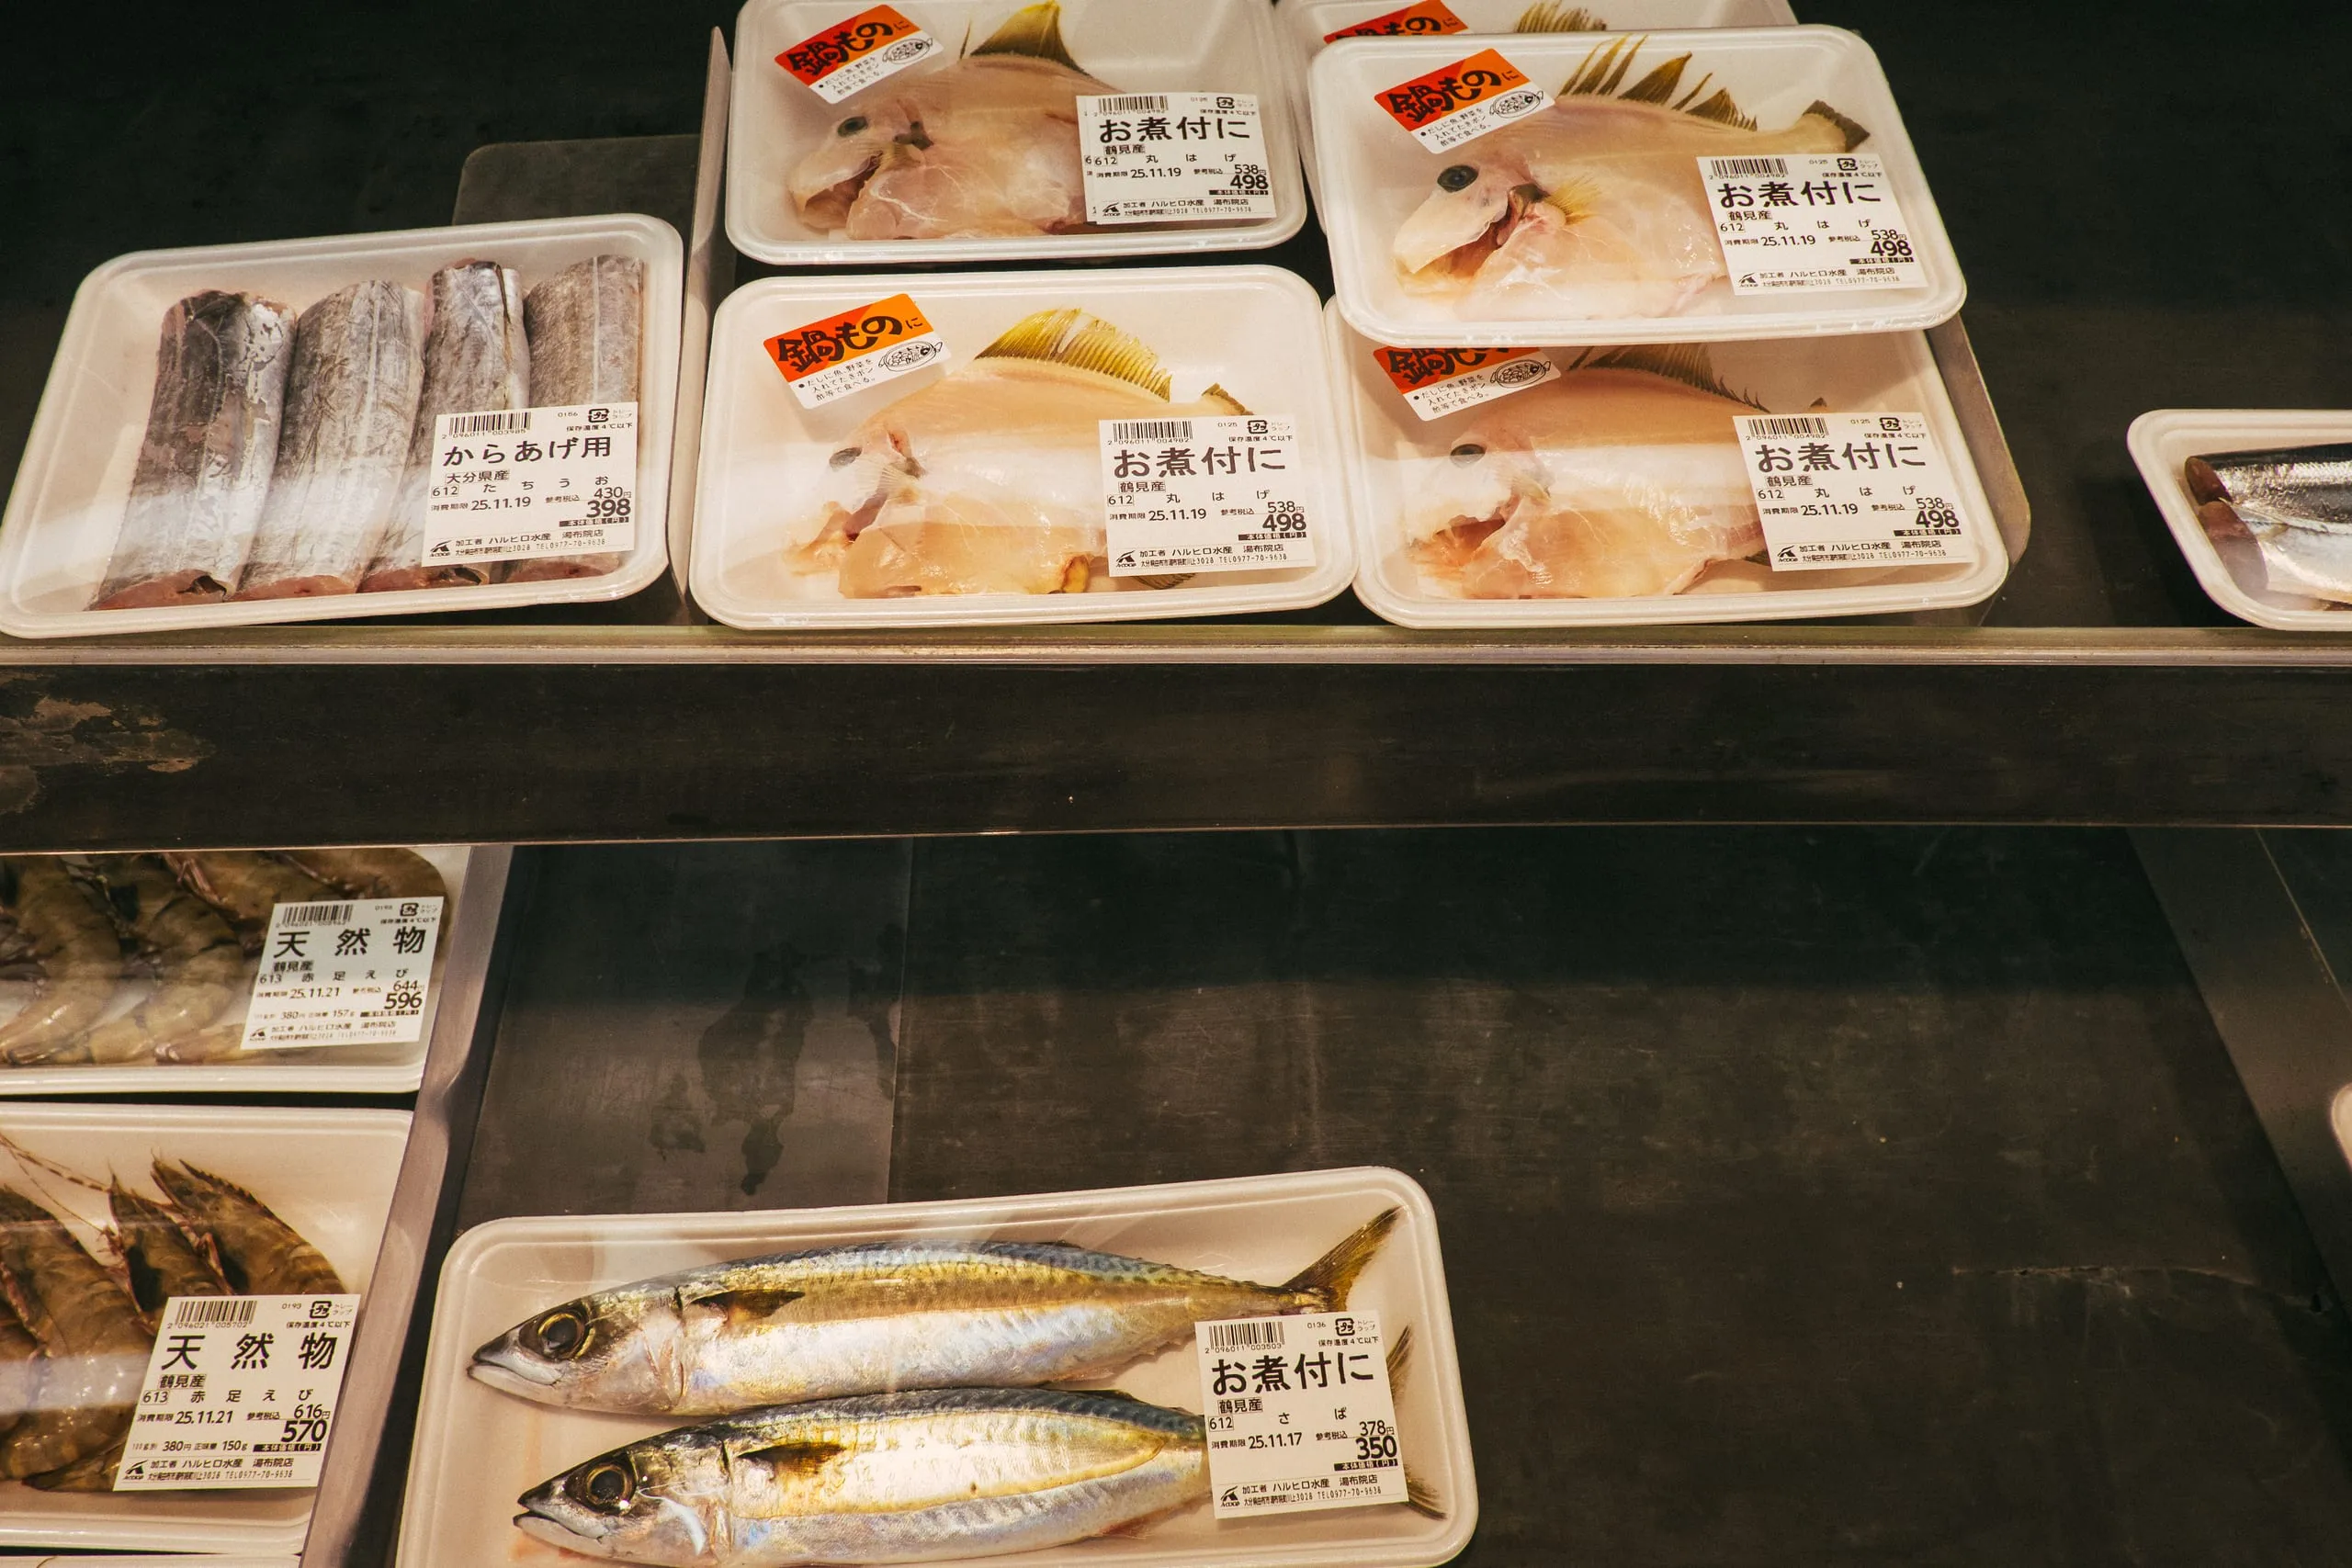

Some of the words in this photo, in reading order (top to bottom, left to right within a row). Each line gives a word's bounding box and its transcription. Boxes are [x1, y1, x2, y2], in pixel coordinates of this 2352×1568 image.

[1387, 70, 1519, 122] 鍋ものに
[1100, 117, 1250, 143] お煮付に
[1105, 144, 1145, 154] 鶴見産
[1131, 168, 1181, 178] 25.11.19
[1230, 175, 1268, 189] 498
[1717, 181, 1881, 208] お煮付に
[1728, 211, 1771, 220] 鶴見産
[1721, 223, 1743, 231] 612
[1761, 235, 1815, 246] 25.11.19
[1871, 241, 1912, 256] 498
[1790, 269, 1846, 277] ハルヒロ水産
[778, 316, 922, 372] 鍋ものに
[443, 436, 610, 467] からあげ用
[1755, 443, 1926, 472] お煮付に
[1114, 446, 1285, 478] お煮付に
[447, 470, 509, 484] 大分県産
[1767, 476, 1812, 487] 鶴見産
[433, 486, 458, 497] 612
[594, 487, 631, 499] 430円
[1120, 481, 1165, 492] 鶴見産
[1108, 495, 1133, 504] 612
[1758, 490, 1783, 499] 612
[471, 497, 530, 511] 25.11.19
[586, 499, 630, 518] 398
[1268, 501, 1304, 513] 538円
[1801, 503, 1858, 515] 25.11.19
[1916, 498, 1954, 509] 538円
[1148, 509, 1206, 521] 25.11.19
[1916, 510, 1959, 527] 498
[1262, 513, 1306, 532] 498
[489, 534, 550, 544] ハルヒロ水産
[562, 529, 603, 538] 湯布院店
[1172, 547, 1232, 556] ハルヒロ水産
[1243, 545, 1283, 553] 湯布院店
[1831, 542, 1891, 551] ハルヒロ水産
[1901, 540, 1941, 548] 湯布院店
[274, 927, 426, 958] 天然物
[260, 974, 282, 985] 613
[289, 987, 340, 999] 25.11.21
[384, 992, 422, 1010] 596
[161, 1332, 337, 1371] 天然物
[1212, 1351, 1374, 1395] お煮付に
[159, 1375, 205, 1389] 鶴見産
[142, 1392, 168, 1403] 613
[294, 1404, 330, 1419] 616円
[1219, 1398, 1261, 1414] 鶴見産
[175, 1410, 233, 1424] 25.11.21
[1209, 1417, 1233, 1429] 612
[281, 1420, 327, 1442] 570
[1316, 1431, 1347, 1440] 参考税込
[1359, 1420, 1395, 1436] 378円
[1212, 1438, 1246, 1450] 消費期限
[1249, 1432, 1302, 1450] 25.11.17
[1356, 1436, 1397, 1460] 350
[182, 1458, 242, 1468] ハルヒロ水産
[253, 1458, 293, 1467] 湯布院店
[1242, 1485, 1266, 1494] 加工者
[1273, 1479, 1330, 1492] ハルヒロ水産
[1340, 1474, 1378, 1486] 湯布院店
